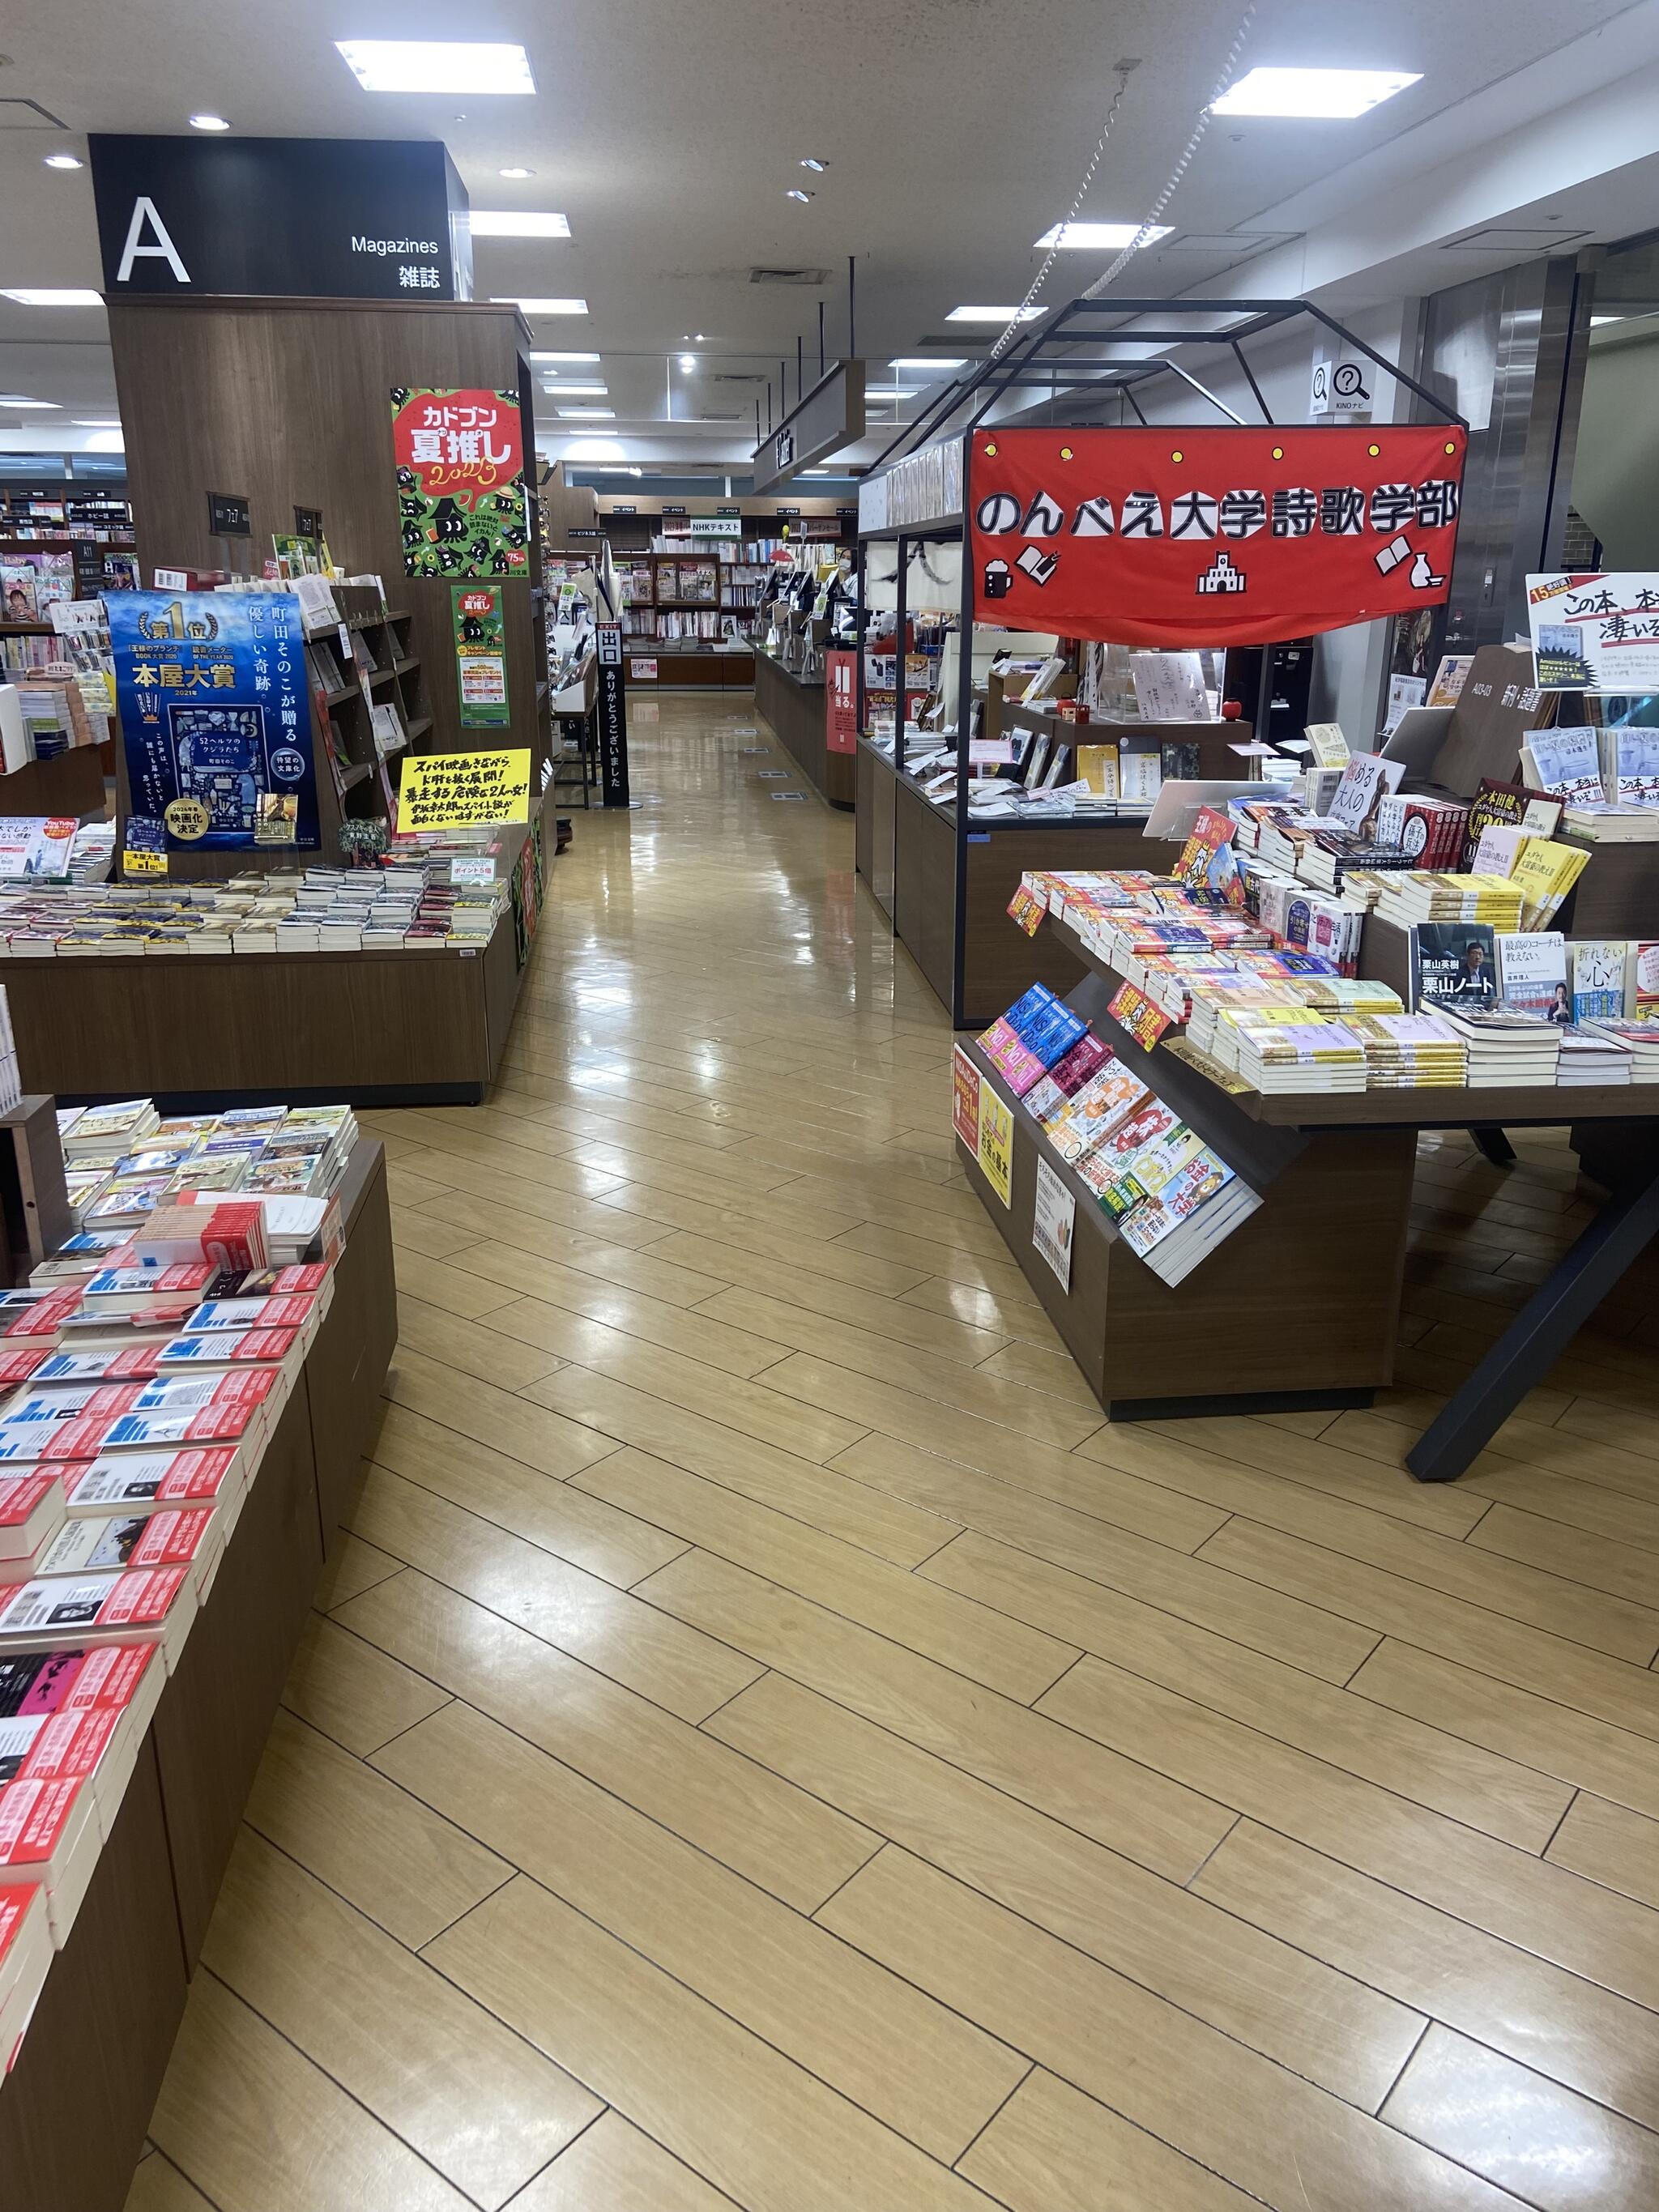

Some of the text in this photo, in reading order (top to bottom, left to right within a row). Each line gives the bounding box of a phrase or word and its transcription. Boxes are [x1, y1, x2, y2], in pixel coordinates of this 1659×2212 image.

[116, 196, 192, 283] A
[352, 235, 439, 257] Magazines
[399, 265, 441, 290] 雑誌
[423, 406, 497, 428] カドブン
[411, 428, 512, 465] 夏推し
[429, 455, 497, 486] 2023
[976, 479, 1458, 540] のんべえ大学詩歌学部
[692, 522, 740, 532] NHKテキスト
[1530, 587, 1549, 602] 15
[1563, 588, 1659, 616] この本、本
[150, 601, 207, 641] 第1位
[602, 631, 617, 663] 出口
[131, 663, 237, 689] 本屋大賞
[271, 606, 297, 742] 町田そのこが贈る
[606, 670, 621, 787] ありがとうございました
[199, 737, 241, 745] 52ヘルツの
[203, 746, 240, 754] クジラたち
[276, 756, 300, 764] 待望の
[278, 765, 301, 773] 文庫化
[1486, 790, 1516, 811] 本田健
[170, 812, 203, 824] 映画化
[177, 823, 200, 834] 決定
[131, 853, 161, 862] 本屋大賞
[454, 867, 492, 875] ポイント5倍
[1504, 936, 1564, 949] 最高のコーチは
[1505, 951, 1542, 963] 教えない。
[1578, 946, 1623, 961] 折れない
[1422, 959, 1460, 970] 栗山英樹
[1586, 960, 1610, 987] 心
[1422, 976, 1494, 995] 栗山ノート
[1183, 1157, 1211, 1183] お金
[1184, 1181, 1194, 1192] の
[1166, 1191, 1196, 1217] 大学
